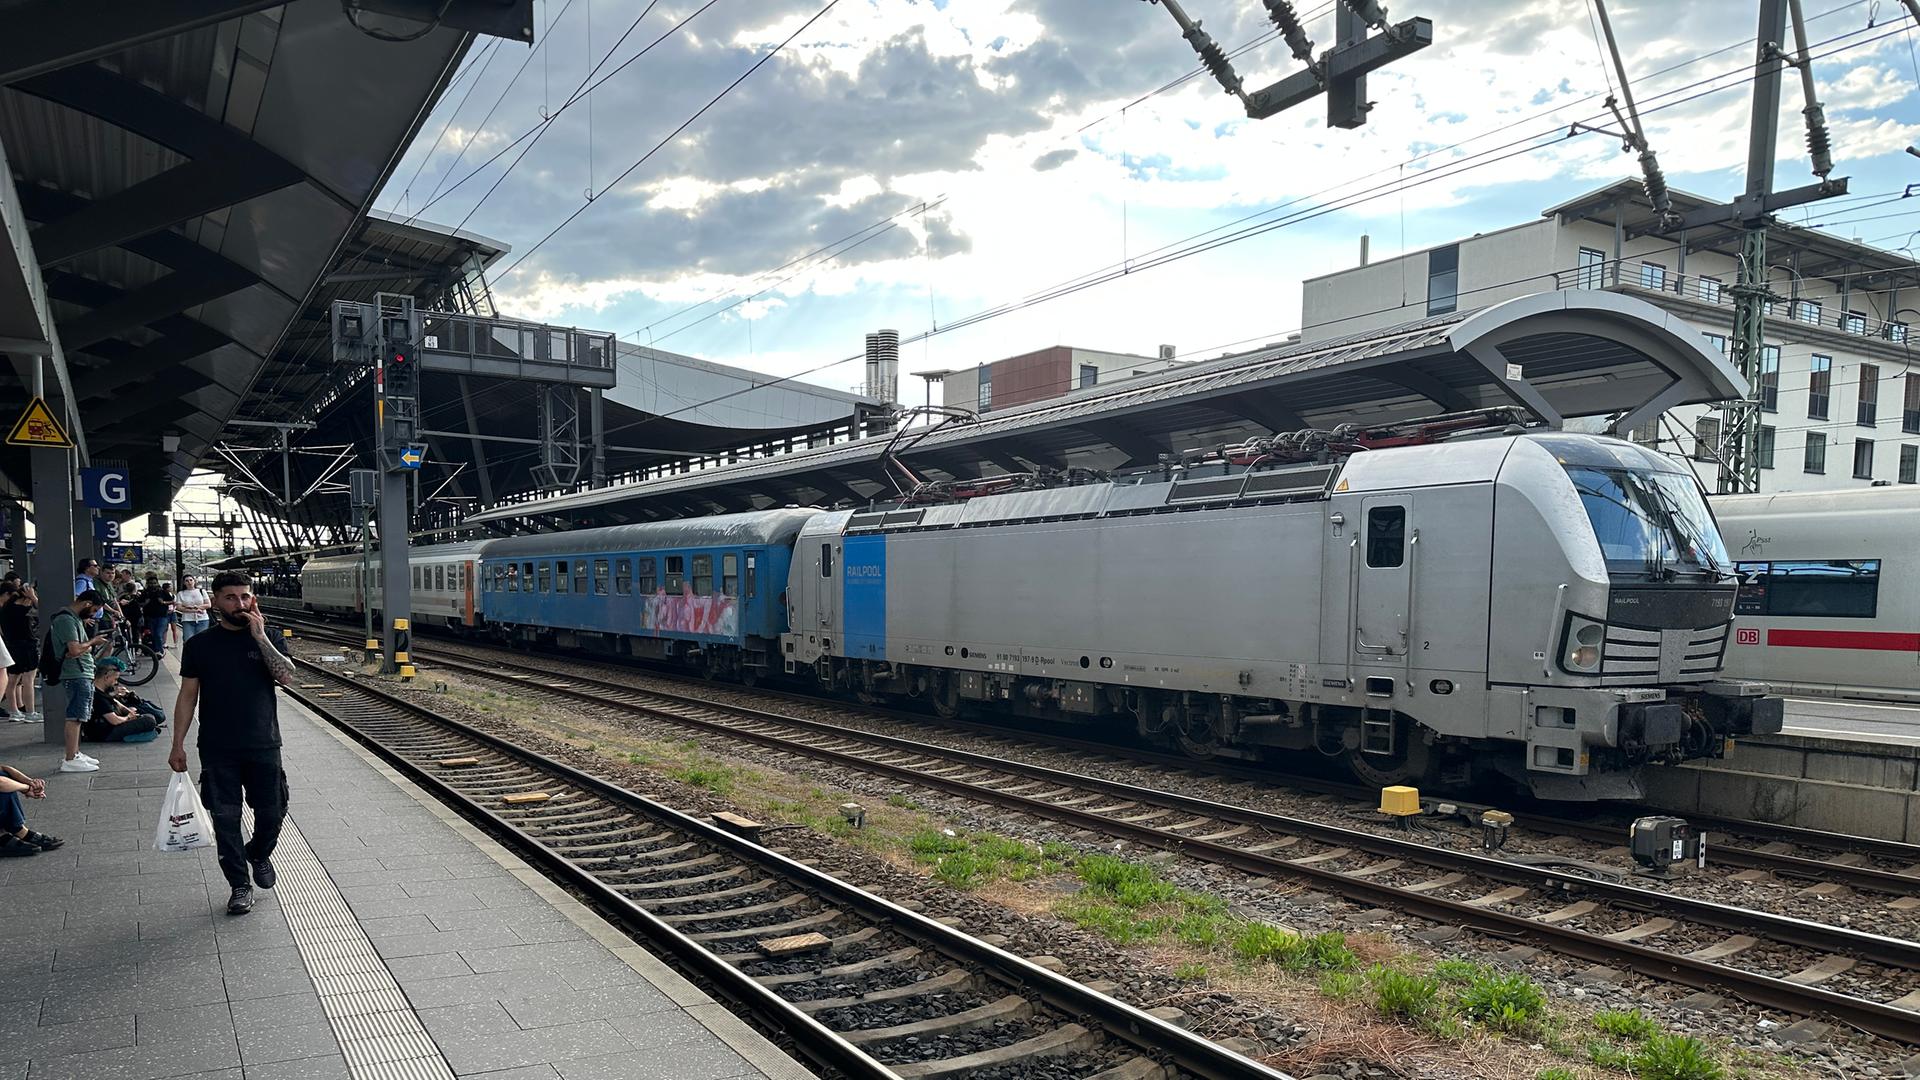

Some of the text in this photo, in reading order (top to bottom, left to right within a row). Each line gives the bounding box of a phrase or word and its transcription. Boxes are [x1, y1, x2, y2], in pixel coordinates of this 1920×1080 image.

[99, 473, 126, 504] G
[106, 520, 120, 539] 3
[847, 565, 882, 577] RAILPOOL
[1739, 630, 1757, 643] DB
[1423, 640, 1430, 650] 2
